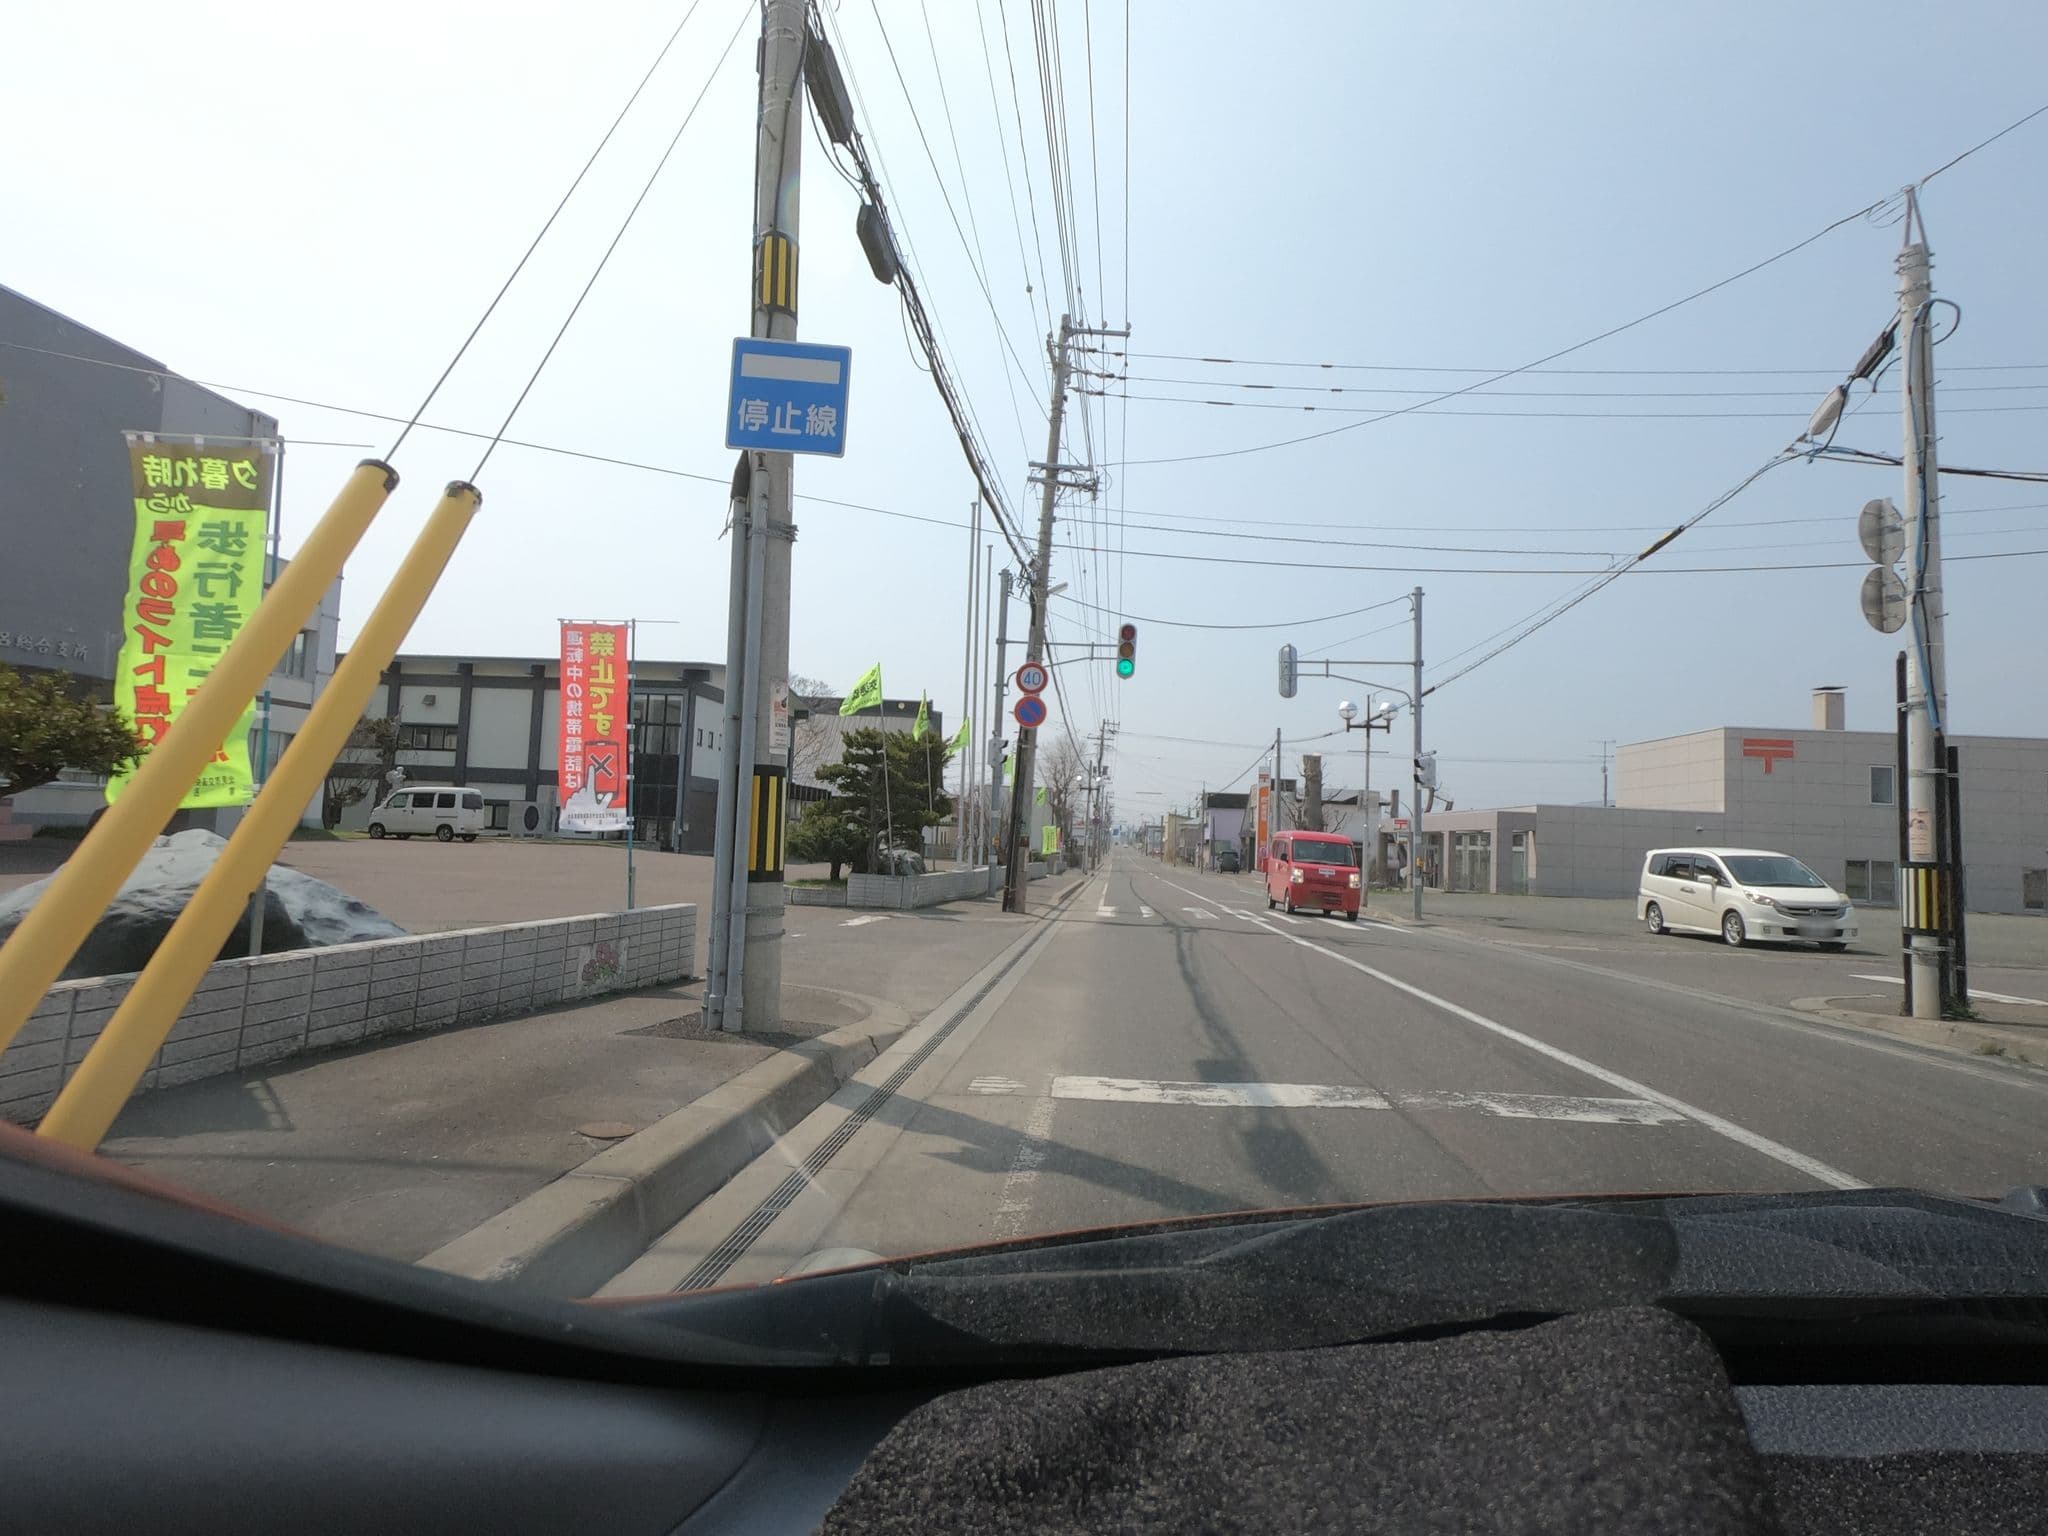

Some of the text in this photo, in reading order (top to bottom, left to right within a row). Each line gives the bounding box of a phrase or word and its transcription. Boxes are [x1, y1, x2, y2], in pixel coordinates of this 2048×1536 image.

[738, 397, 838, 438] 停止線
[1024, 671, 1042, 686] 40
